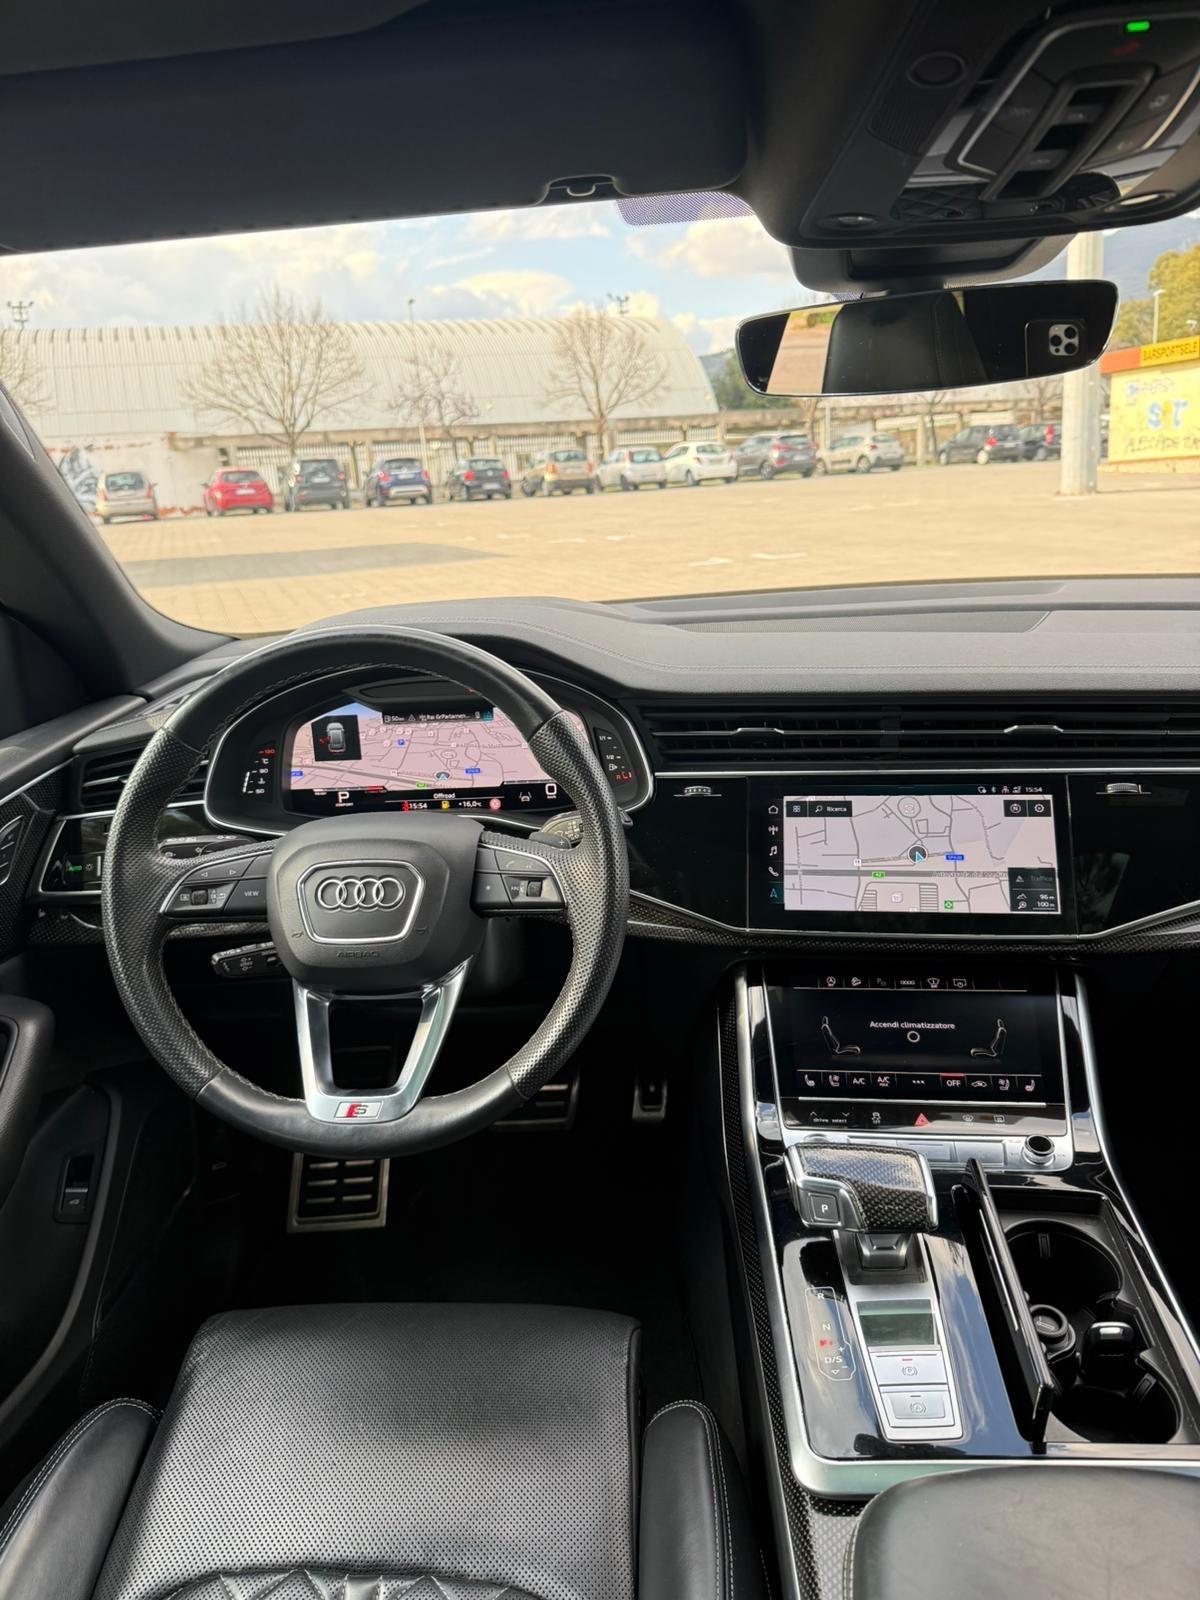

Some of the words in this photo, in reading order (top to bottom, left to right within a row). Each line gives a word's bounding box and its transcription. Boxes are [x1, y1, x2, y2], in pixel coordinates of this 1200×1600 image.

[338, 791, 350, 803] P
[900, 1021, 956, 1029] climatizzatore
[821, 1204, 829, 1214] P
[817, 1292, 825, 1300] R
[822, 1323, 831, 1331] N
[824, 1356, 843, 1364] D/S
